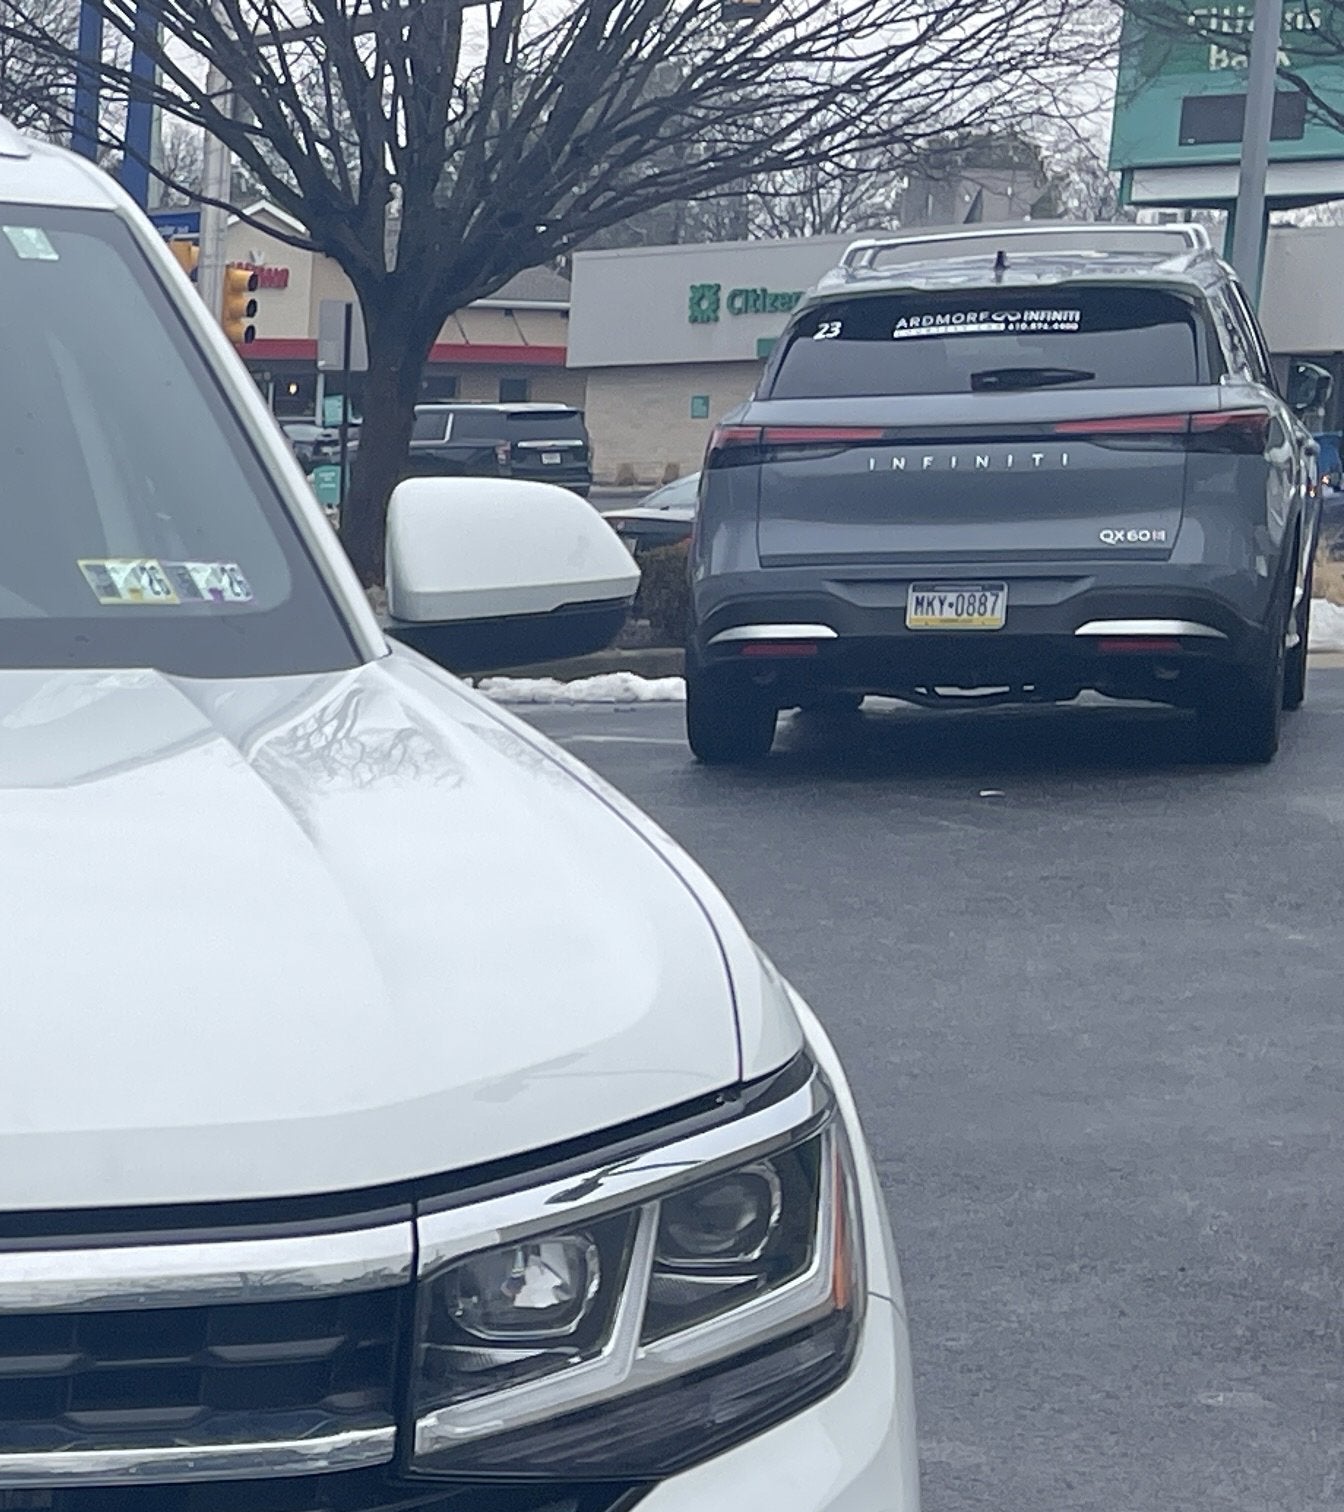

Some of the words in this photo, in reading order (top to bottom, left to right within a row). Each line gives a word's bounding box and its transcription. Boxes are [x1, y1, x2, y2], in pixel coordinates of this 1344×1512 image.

[1209, 39, 1292, 71] Bak
[1023, 310, 1081, 322] INFINITI
[813, 321, 842, 340] 23
[868, 453, 1069, 472] INFINITI
